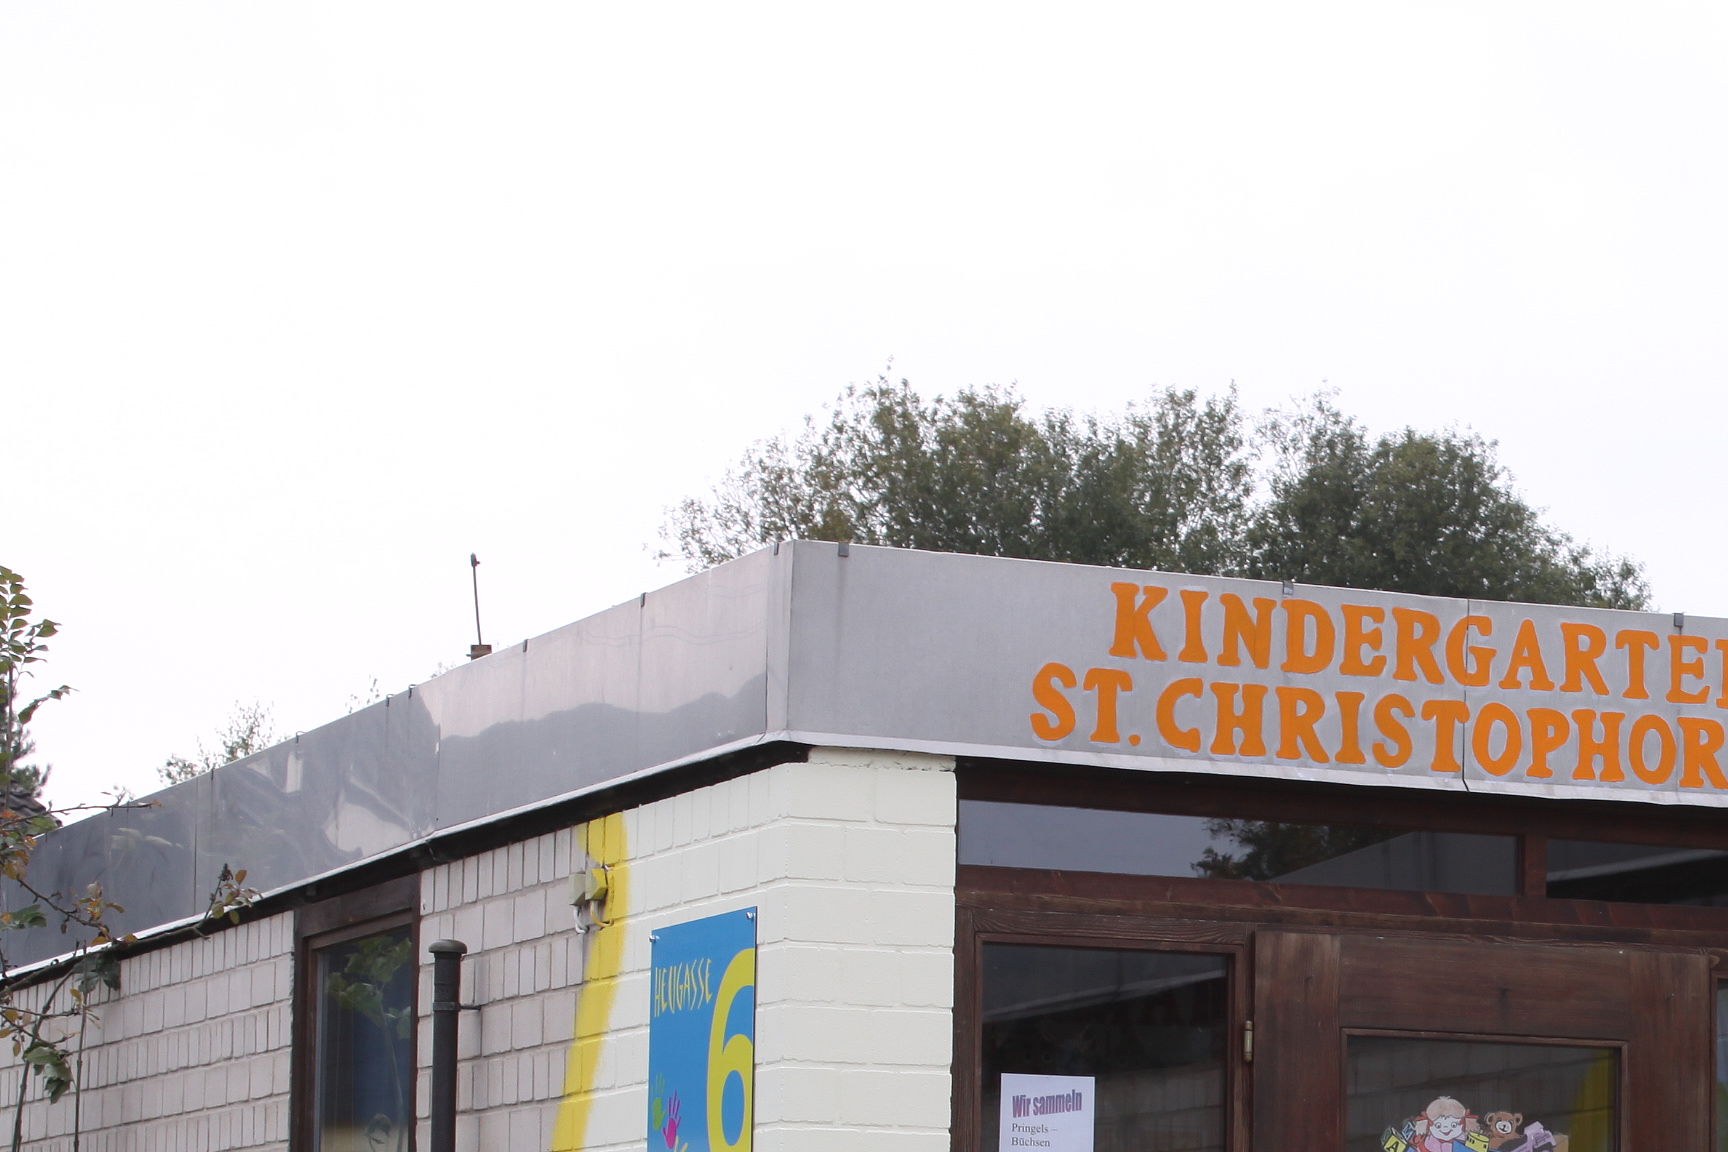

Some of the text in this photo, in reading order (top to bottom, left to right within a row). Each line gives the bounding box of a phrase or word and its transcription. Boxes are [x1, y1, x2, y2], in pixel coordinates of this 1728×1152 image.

[1030, 662, 1141, 746] ST.
[654, 957, 713, 1018] HEUGASSE
[1012, 1089, 1083, 1119] Wir sammeln
[1010, 1136, 1050, 1148] Büchsen
[1011, 1122, 1049, 1136] Pringels
